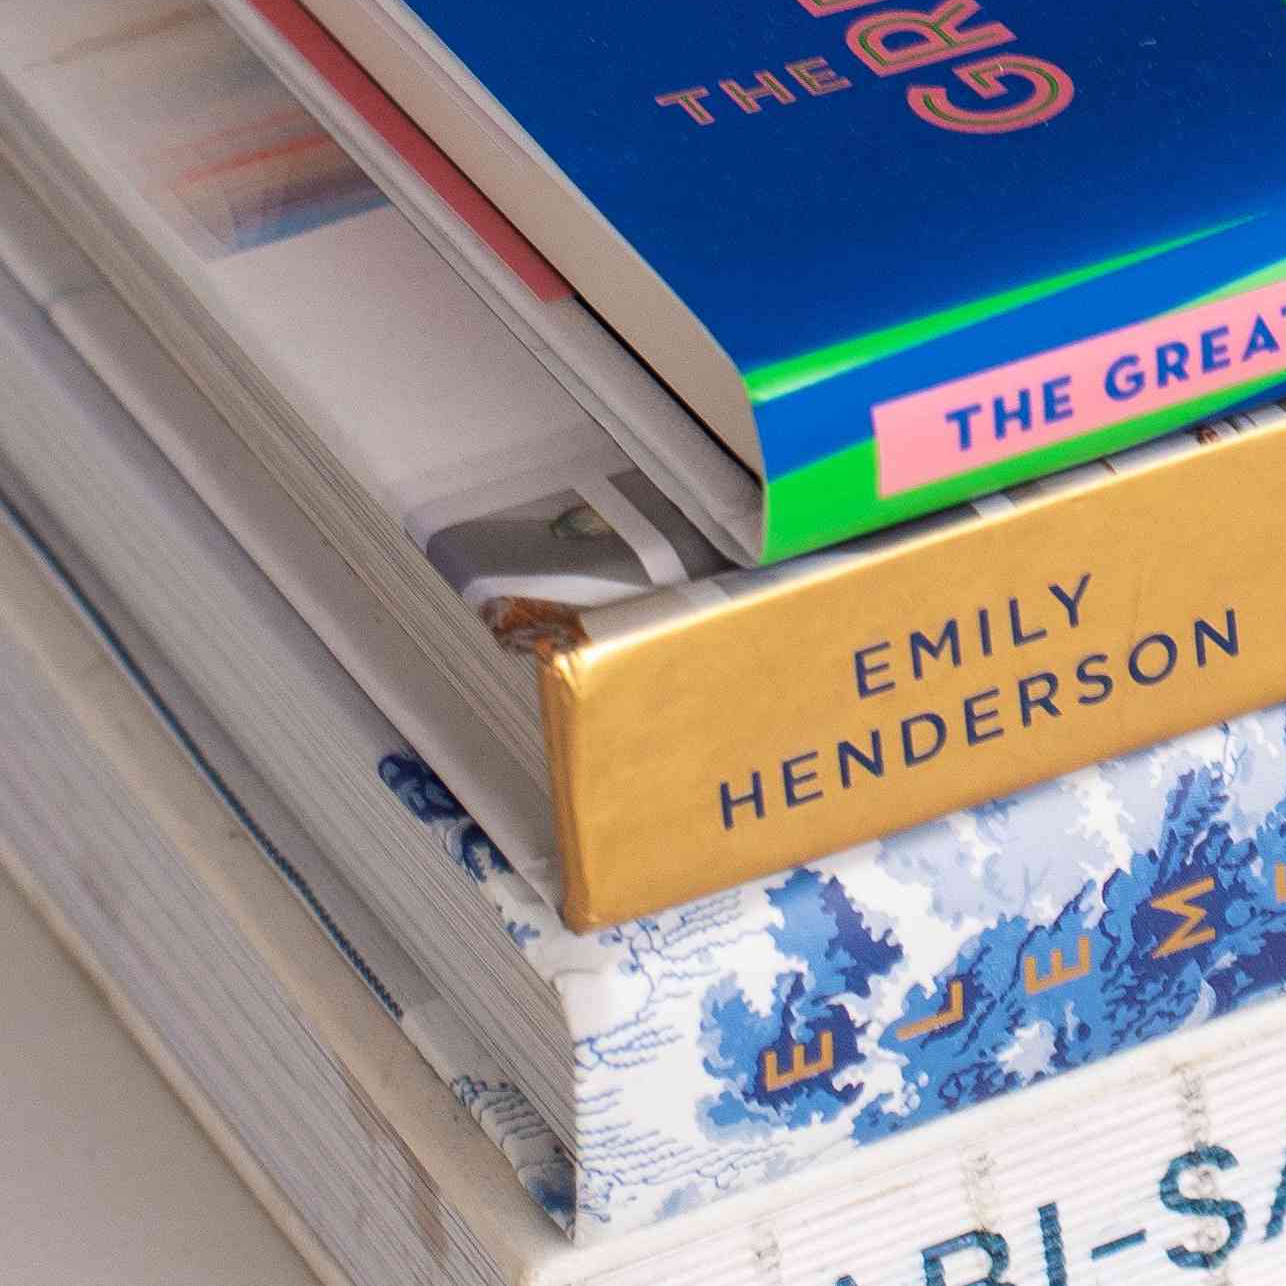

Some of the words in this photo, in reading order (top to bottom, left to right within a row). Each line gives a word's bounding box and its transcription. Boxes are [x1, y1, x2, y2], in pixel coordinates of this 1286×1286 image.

[655, 57, 852, 126] THE
[946, 375, 1075, 451] THE
[853, 571, 1092, 700] EMILY
[719, 606, 1240, 831] HENDERSON
